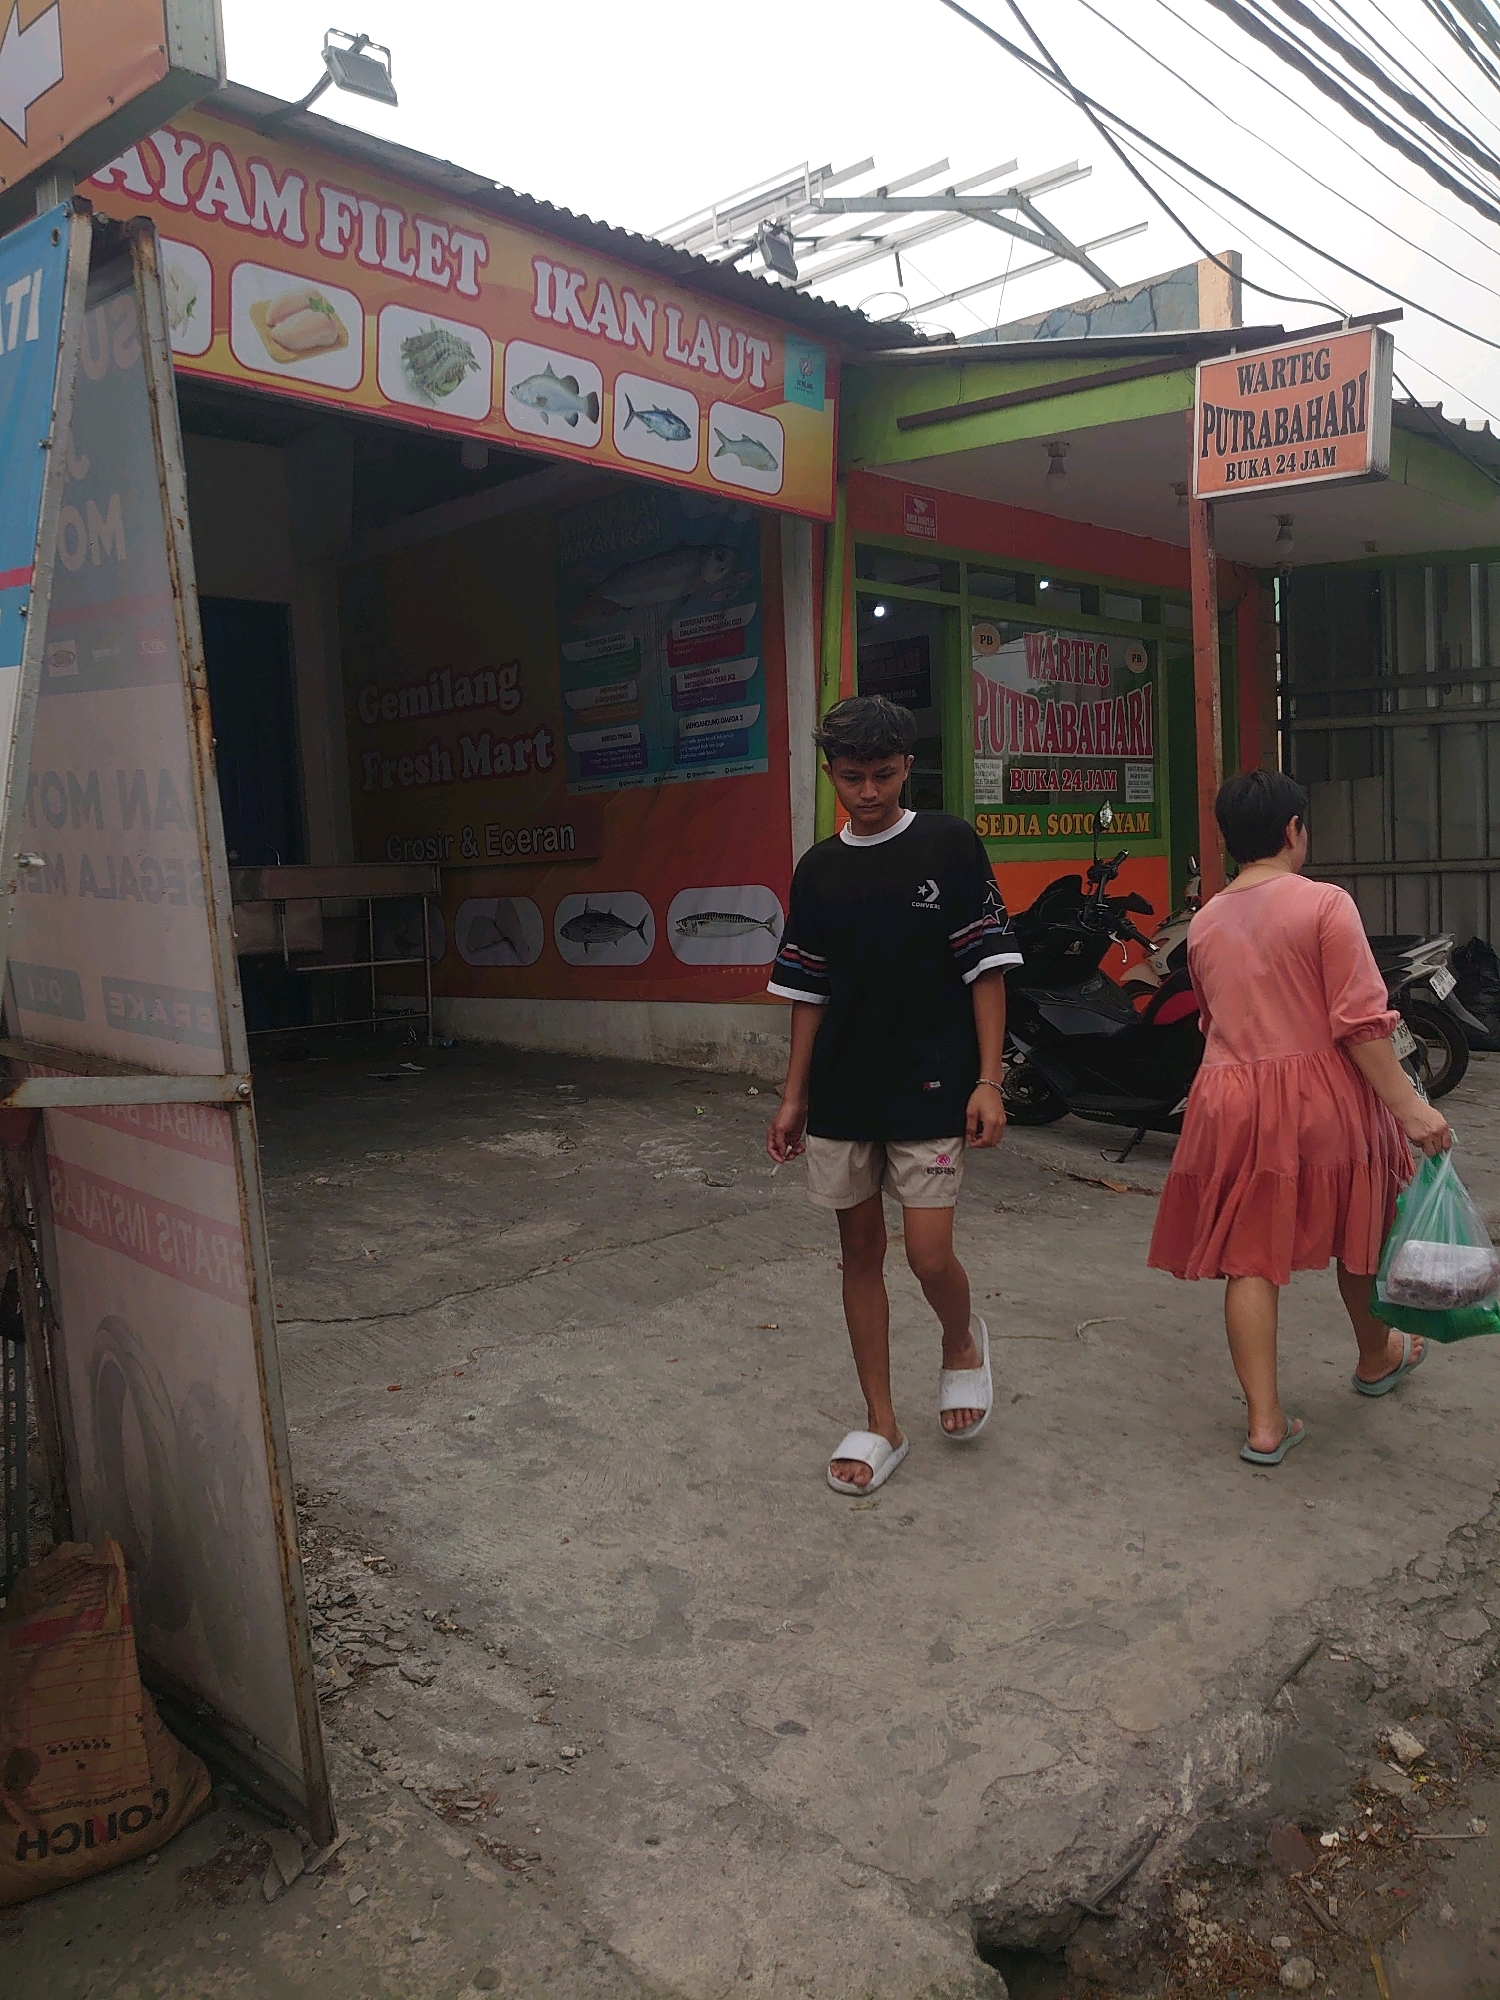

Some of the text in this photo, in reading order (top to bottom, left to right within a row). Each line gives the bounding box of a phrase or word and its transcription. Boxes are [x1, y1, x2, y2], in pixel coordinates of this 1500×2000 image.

[317, 185, 489, 297] FILET
[532, 258, 657, 354] IKAN
[664, 307, 772, 390] LAUT
[1236, 347, 1332, 397] WARTEG
[1201, 370, 1369, 459] PUTRABAHARI
[1225, 446, 1337, 483] BUKA 24 JAM
[979, 634, 994, 646] PB
[1023, 631, 1111, 688] WARTEG
[357, 662, 522, 724] Gemilang
[973, 669, 1154, 758] PUTRABAHARI
[361, 741, 453, 793] Fresh
[460, 728, 554, 779] Mart
[1010, 768, 1060, 791] BUKA
[1062, 769, 1082, 792] 24
[1084, 770, 1117, 792] JAM
[386, 823, 575, 862] Grosir & Eceran
[975, 813, 1042, 837] SEDIA
[1047, 812, 1096, 837] SOTO
